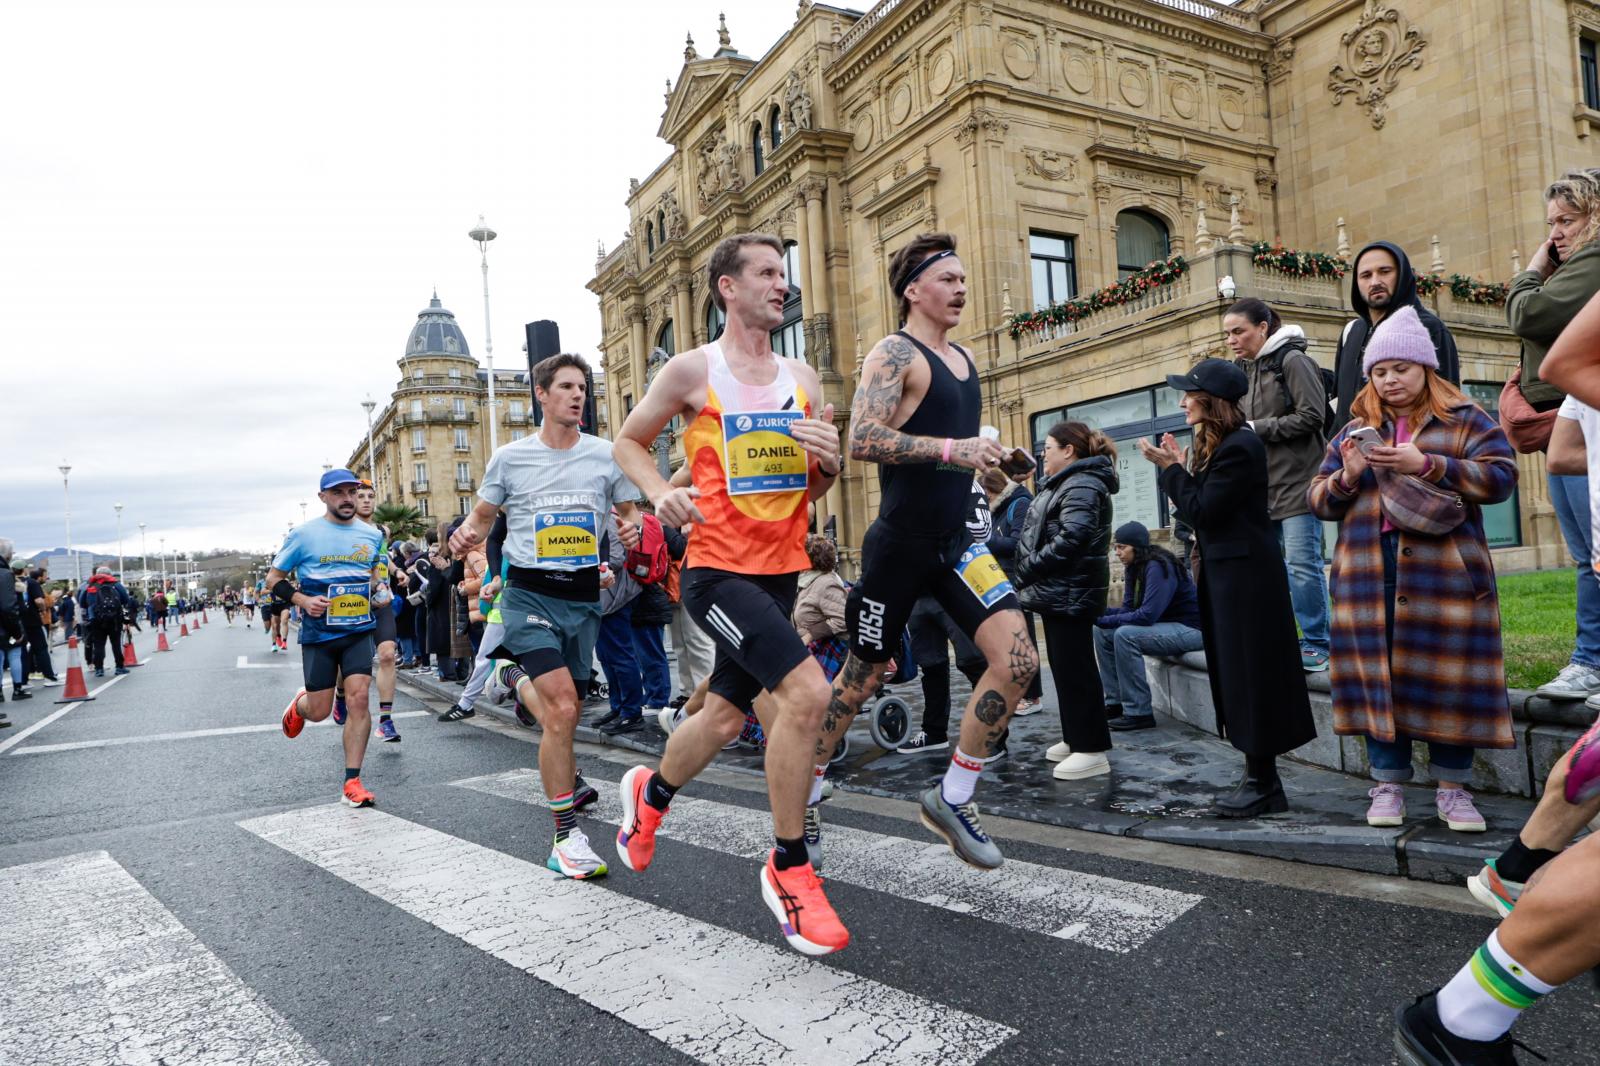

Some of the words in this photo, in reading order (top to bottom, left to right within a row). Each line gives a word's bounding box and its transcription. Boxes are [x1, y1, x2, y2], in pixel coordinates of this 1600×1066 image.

[757, 418, 793, 427] ZURICH
[747, 446, 798, 459] DANIEL
[764, 464, 783, 473] 493
[535, 495, 597, 507] ANCRAGE
[558, 515, 587, 523] ZURICH
[548, 535, 592, 546] MAXIME
[561, 548, 577, 556] 365
[858, 597, 886, 650] PSRC
